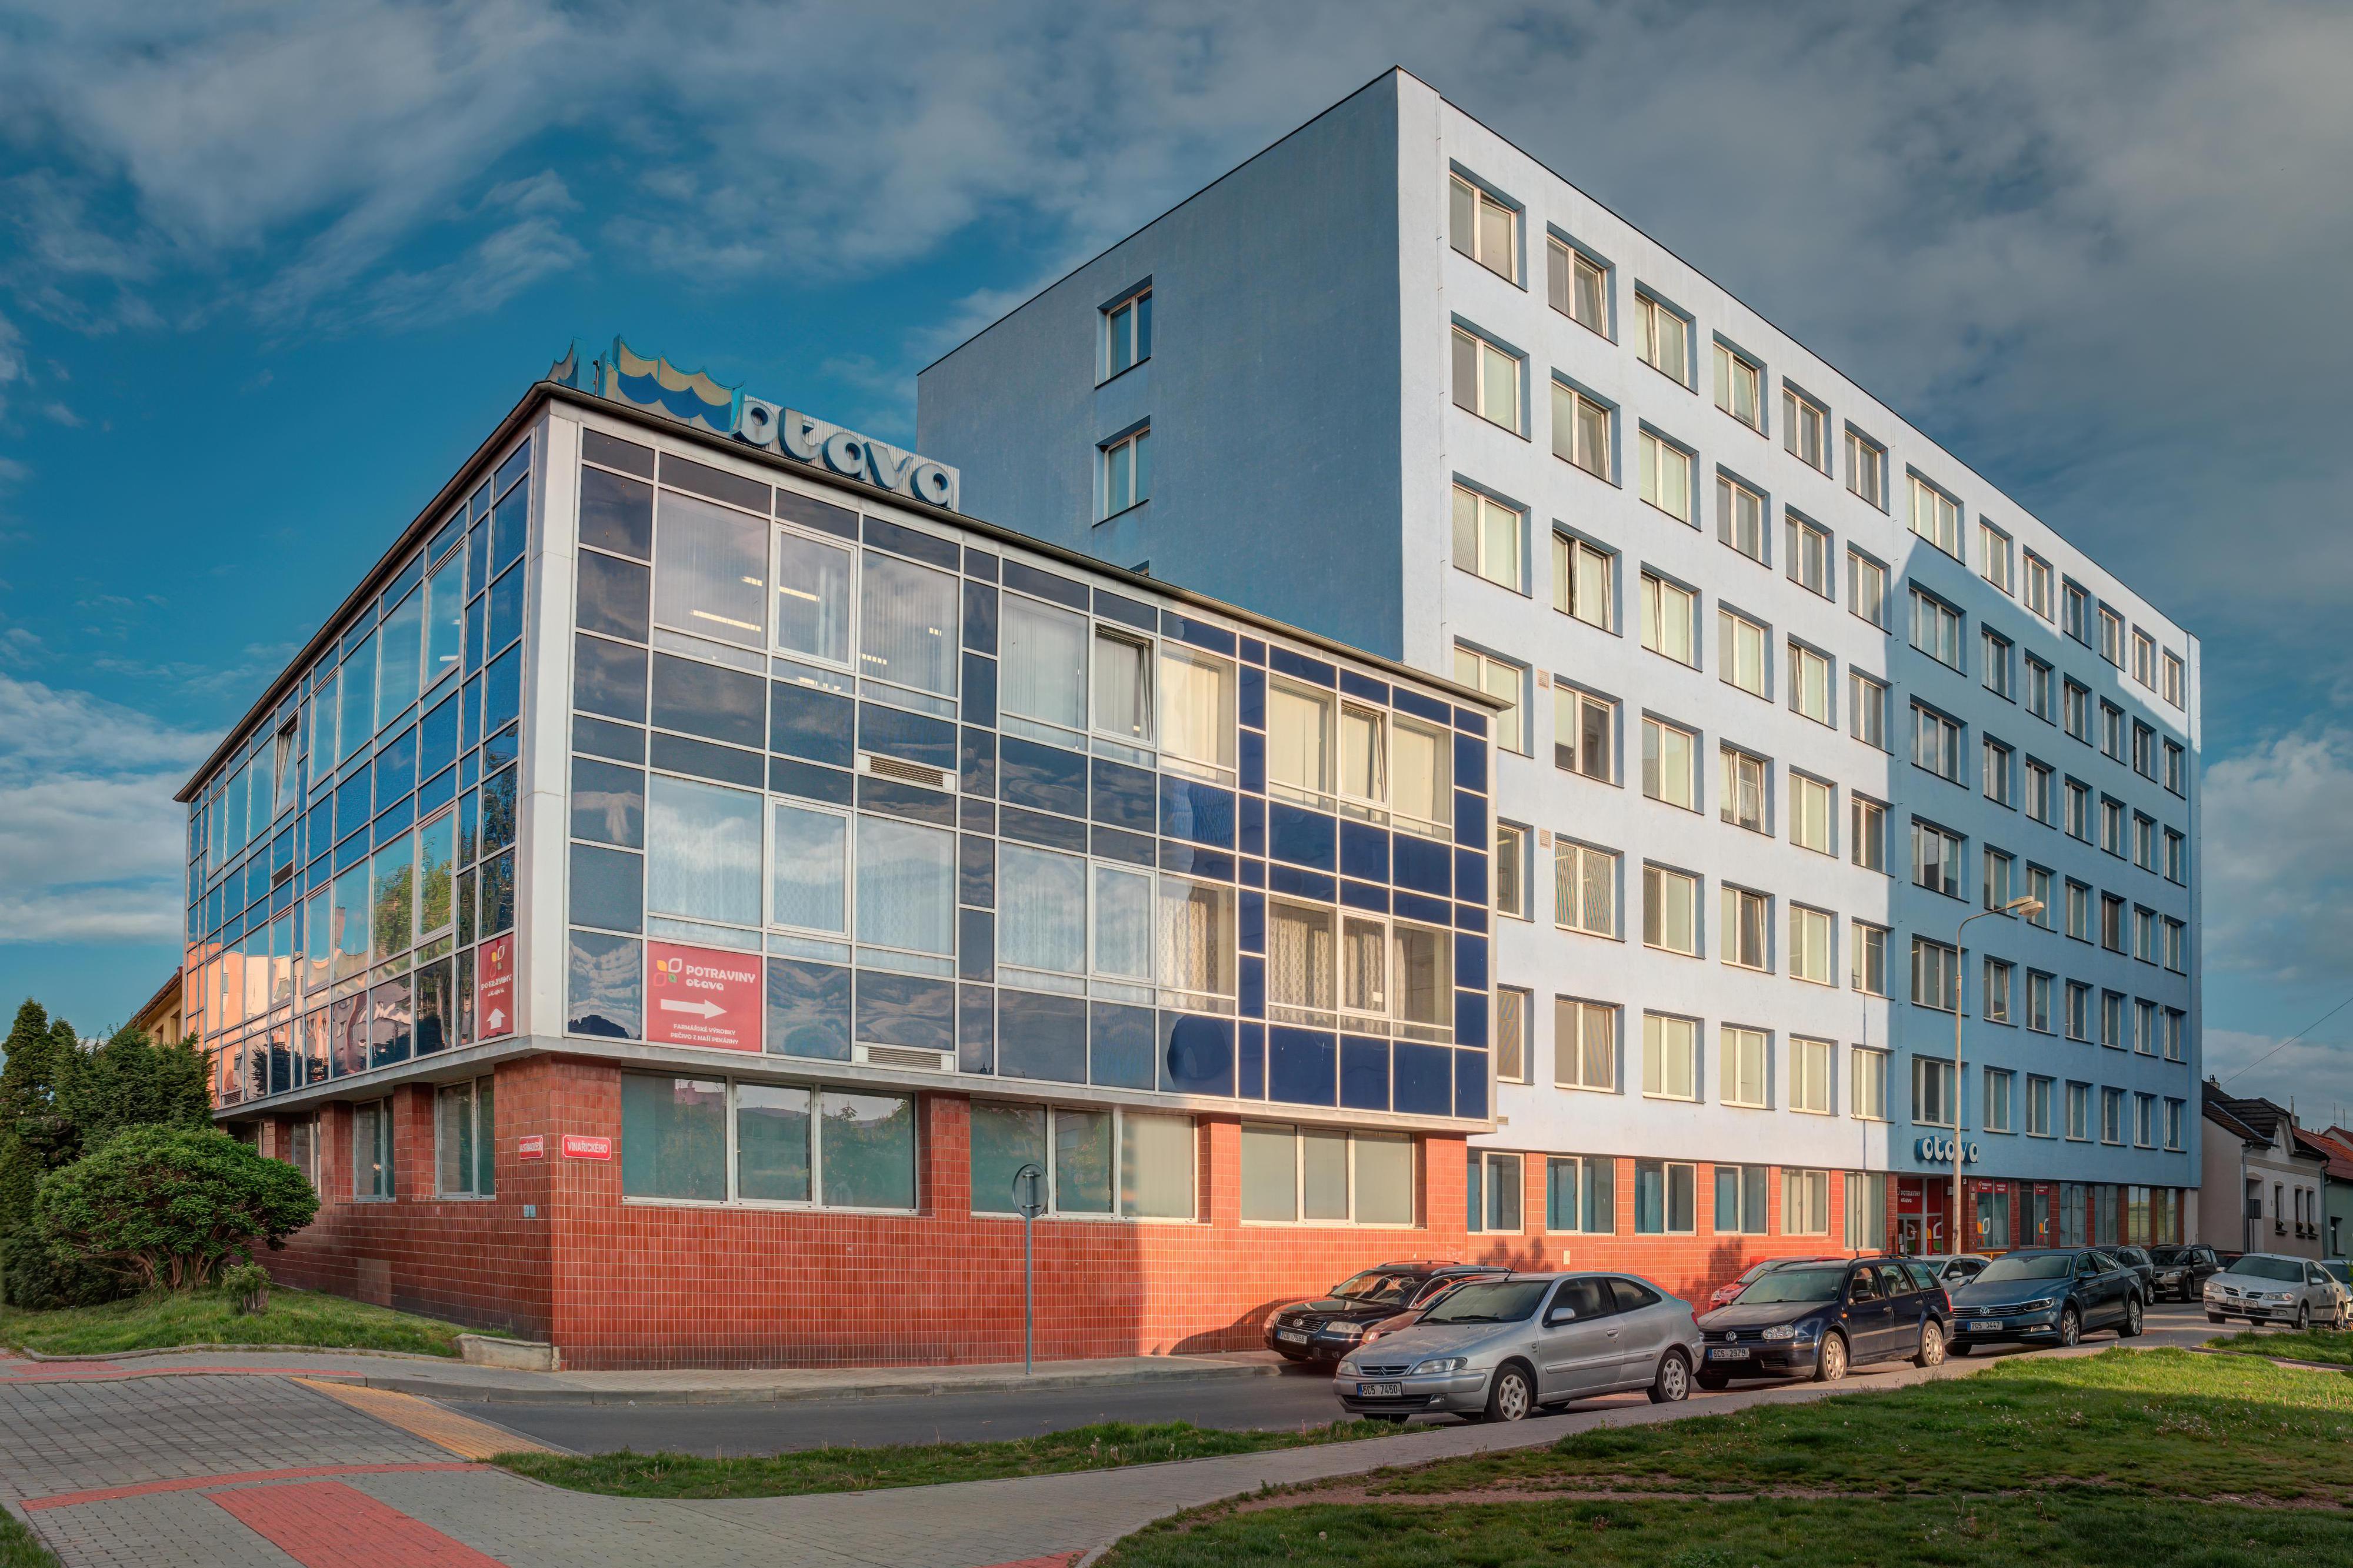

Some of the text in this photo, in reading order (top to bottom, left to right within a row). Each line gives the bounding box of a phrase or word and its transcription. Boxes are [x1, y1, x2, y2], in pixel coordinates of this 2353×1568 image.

[733, 400, 954, 510] otava
[686, 965, 756, 983] POTRAVINY
[685, 979, 724, 991] otava
[708, 1027, 736, 1035] VÝROBKY
[712, 1036, 739, 1045] PEKÁRNY
[567, 1140, 608, 1153] VINAŘICKÉHO
